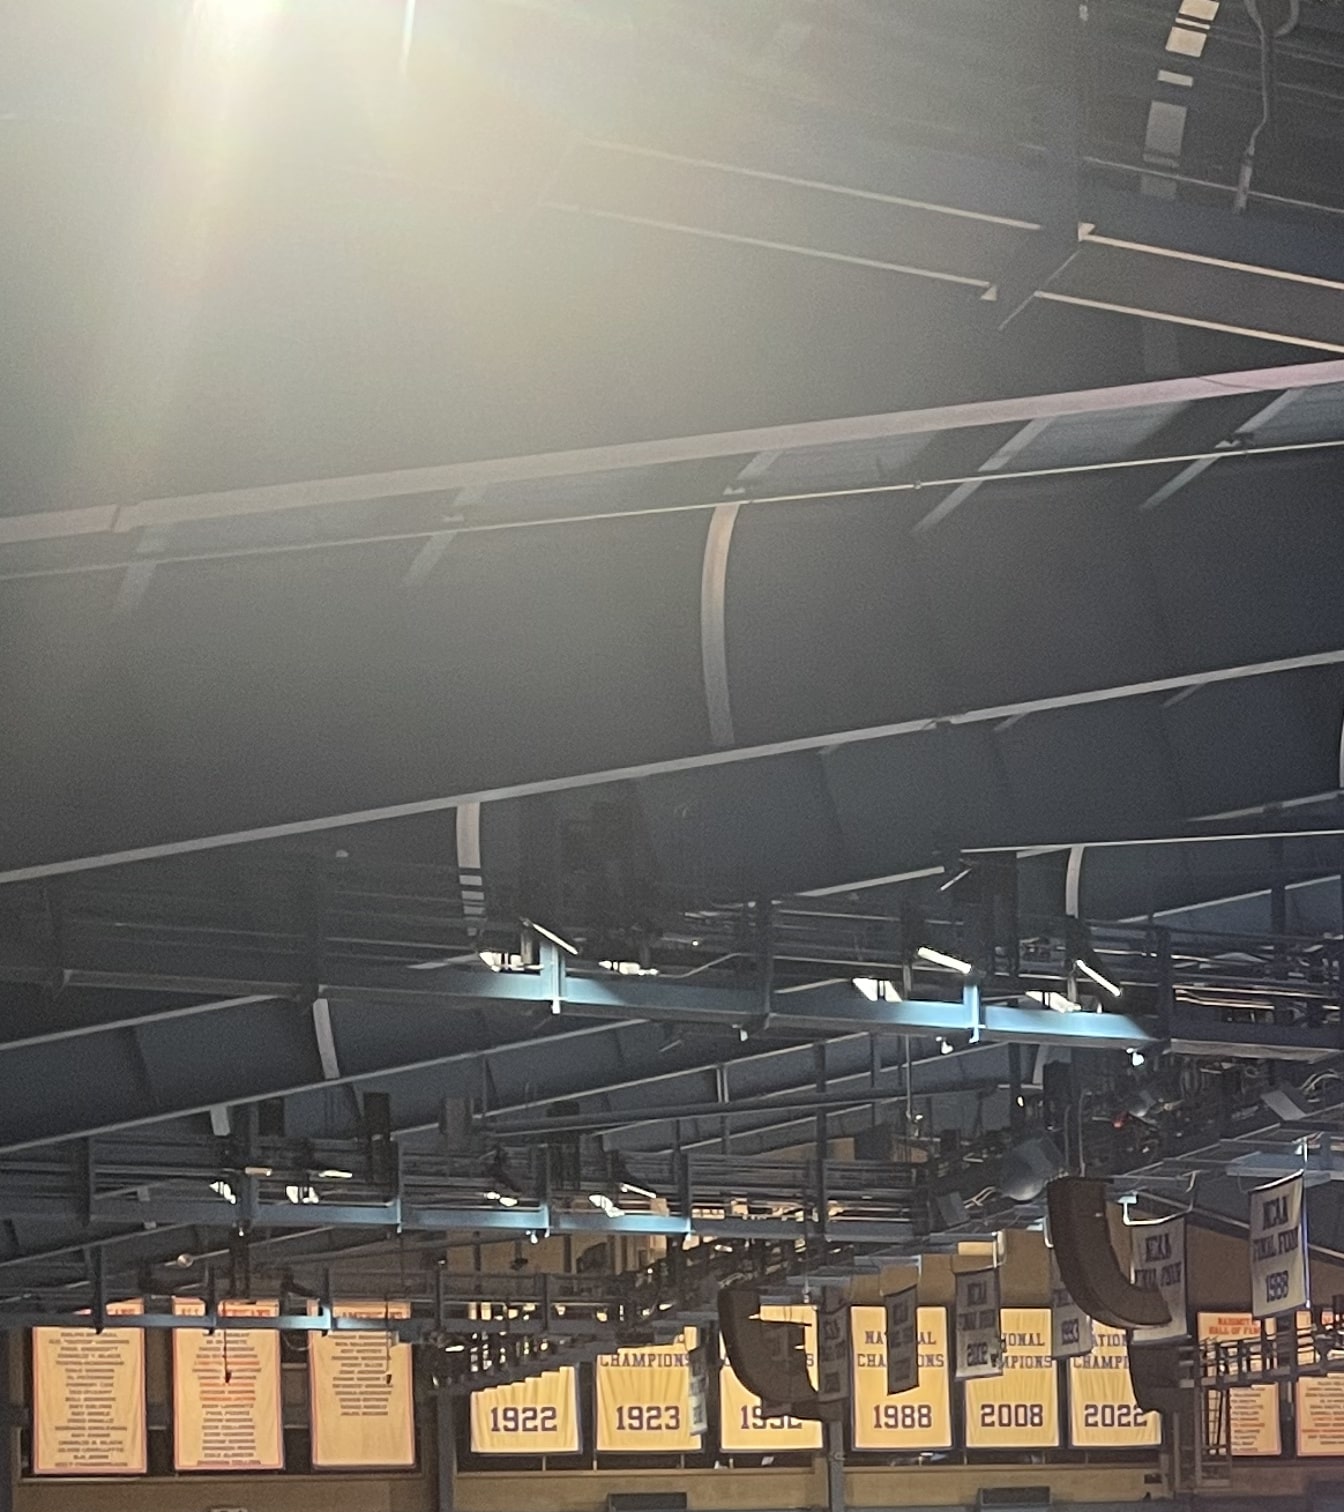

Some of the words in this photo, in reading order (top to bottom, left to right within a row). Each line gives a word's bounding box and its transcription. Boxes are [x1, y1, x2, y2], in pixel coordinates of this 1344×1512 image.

[1262, 1195, 1289, 1231] NCAA
[490, 1406, 559, 1432] 1922
[616, 1405, 681, 1430] 1923
[873, 1404, 933, 1429] 1988
[980, 1404, 1044, 1427] 2008
[1084, 1404, 1148, 1428] 2022
